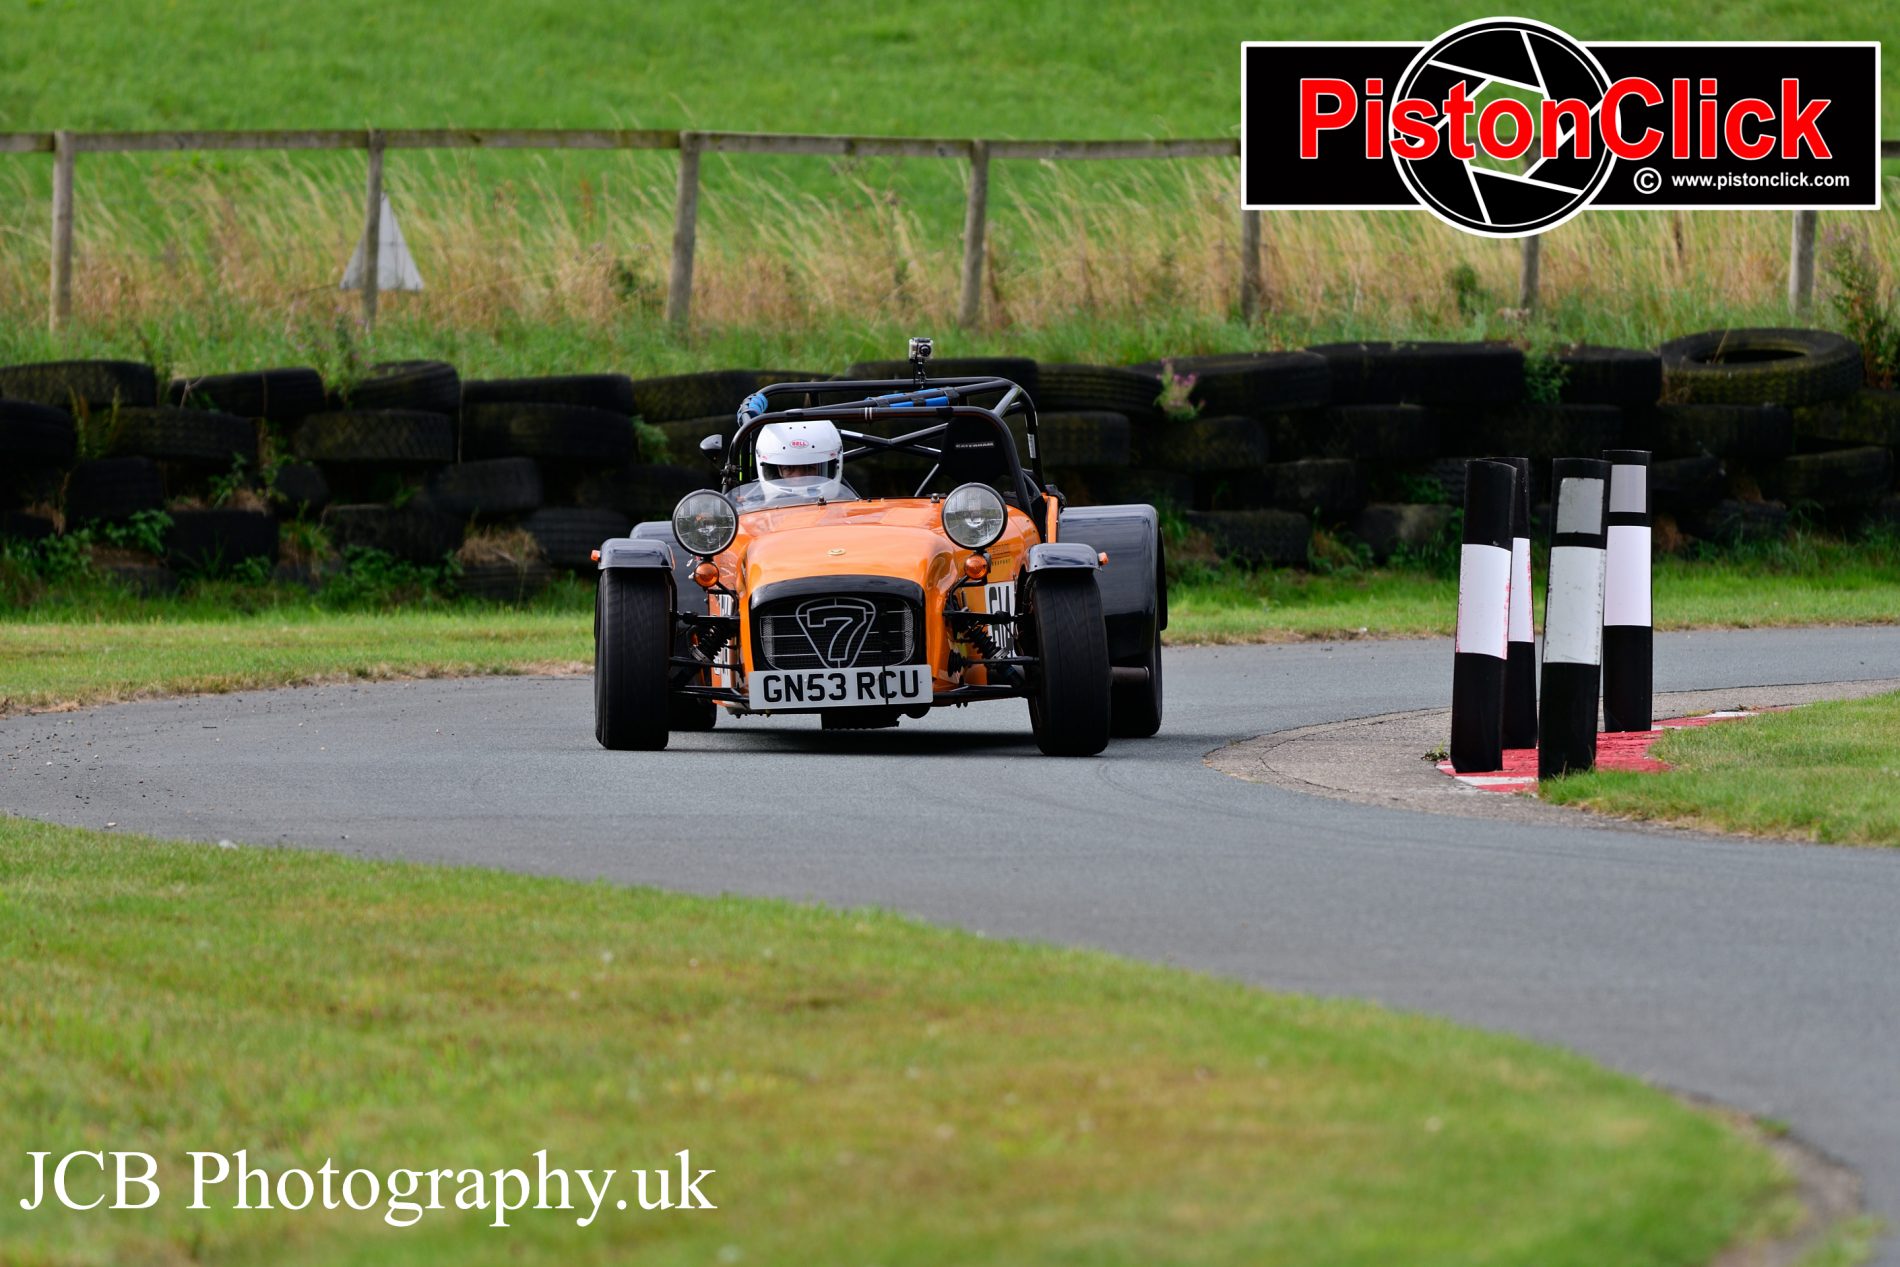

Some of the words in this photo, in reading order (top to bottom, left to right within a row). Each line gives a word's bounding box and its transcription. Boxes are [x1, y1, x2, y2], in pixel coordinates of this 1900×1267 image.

[806, 604, 867, 662] 7
[763, 672, 847, 703] GN53
[856, 669, 919, 701] RCU
